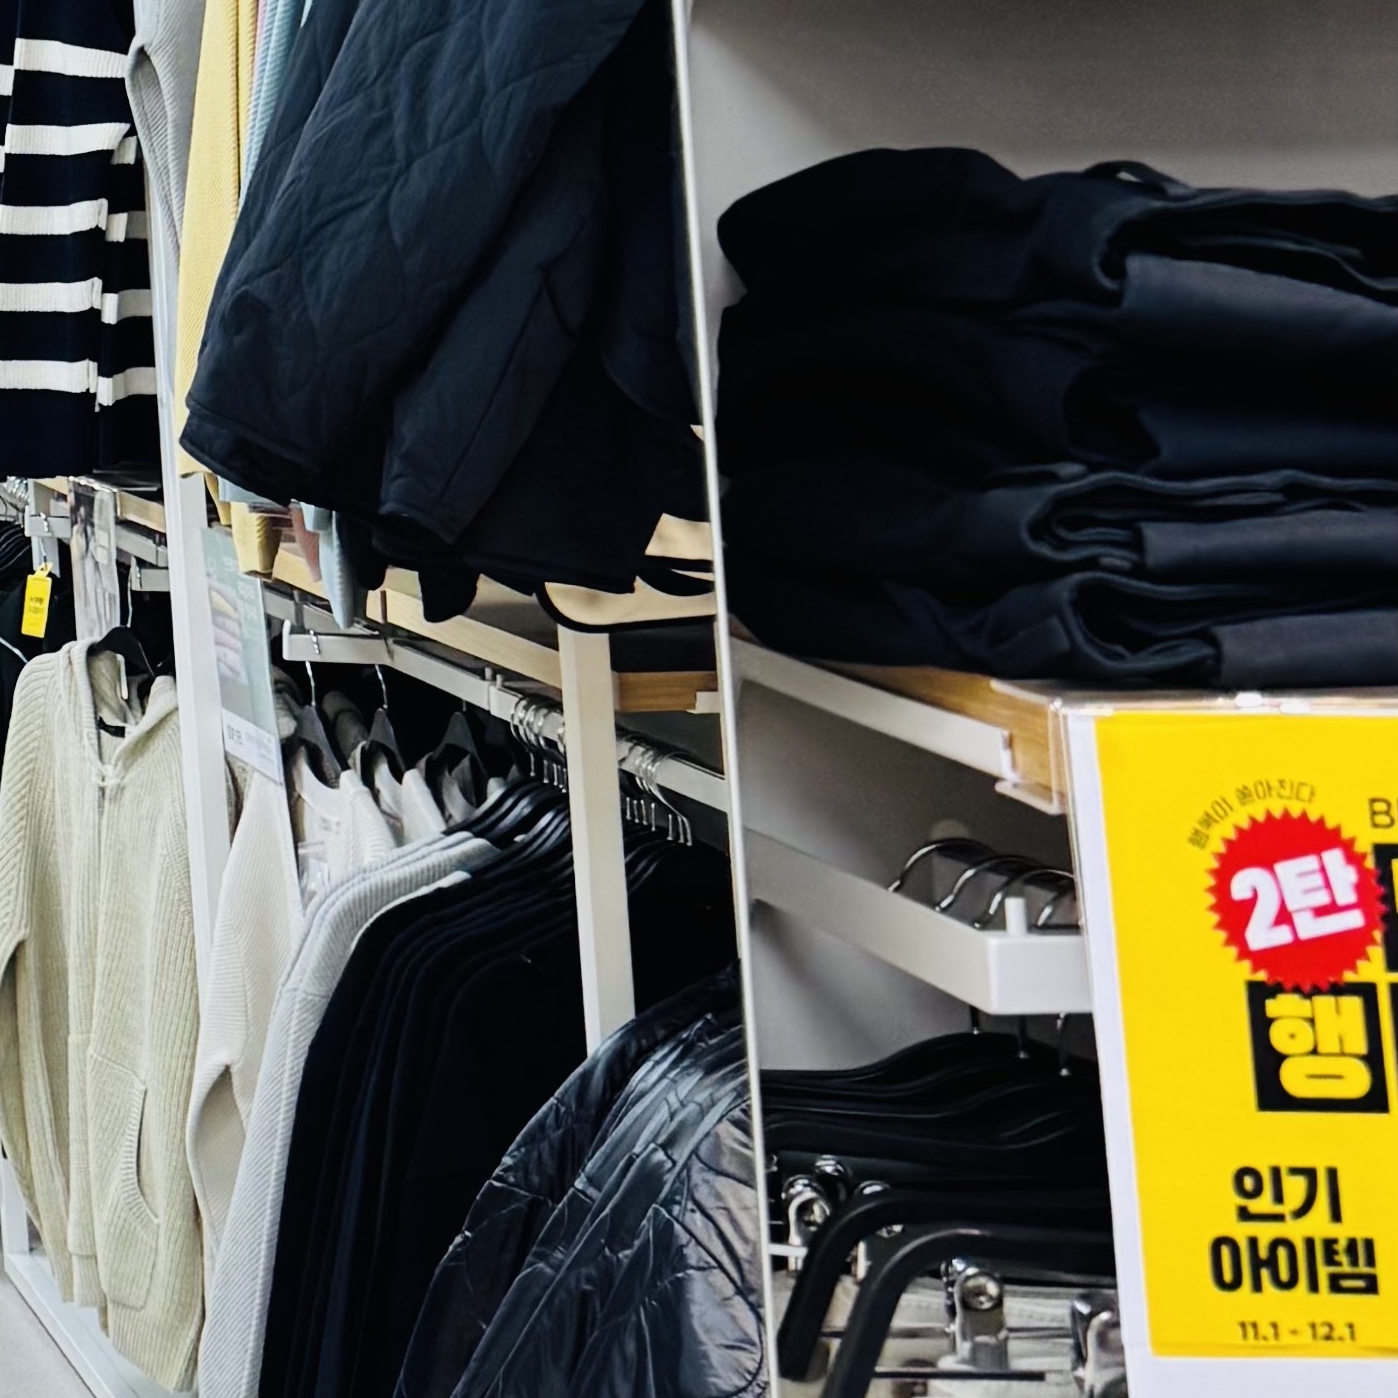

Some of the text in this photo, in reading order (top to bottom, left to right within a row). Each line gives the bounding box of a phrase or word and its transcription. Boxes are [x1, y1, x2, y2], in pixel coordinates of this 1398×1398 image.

[1230, 848, 1365, 952] 2탄
[1233, 1164, 1343, 1224] 인기
[1209, 1235, 1380, 1297] 아이템
[1237, 1319, 1282, 1342] 11.1
[1309, 1318, 1357, 1342] 12.1
